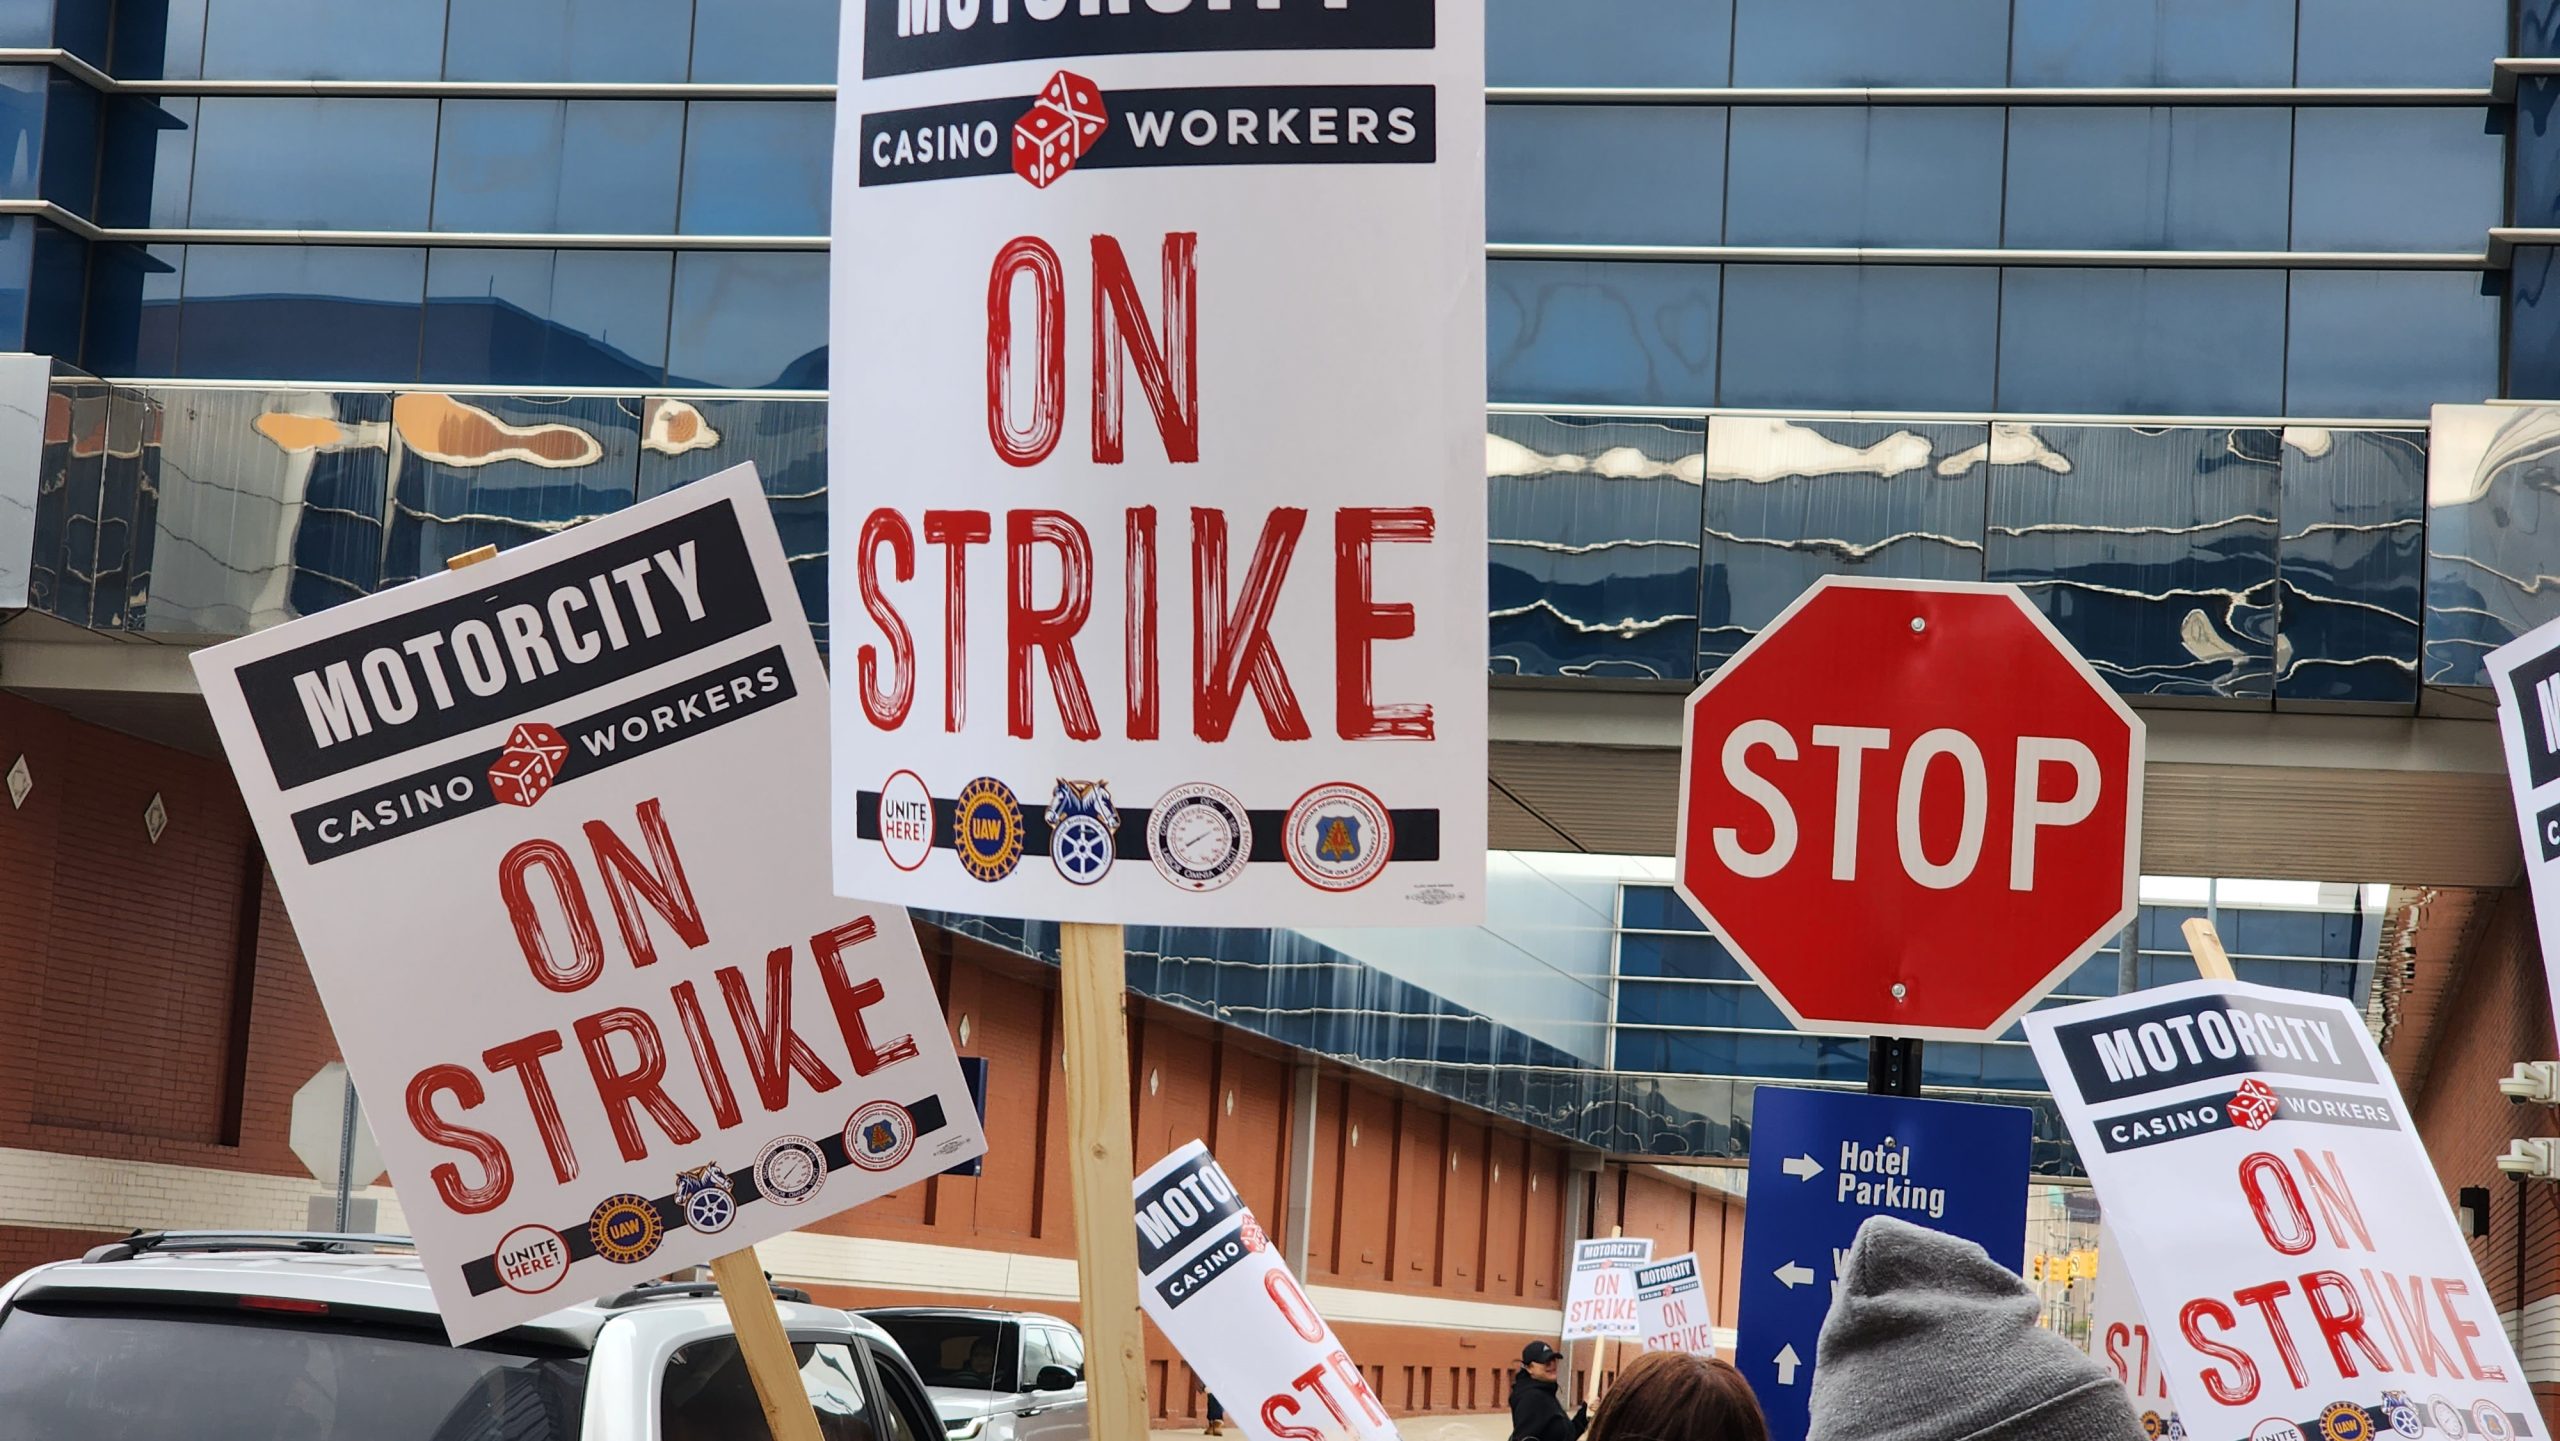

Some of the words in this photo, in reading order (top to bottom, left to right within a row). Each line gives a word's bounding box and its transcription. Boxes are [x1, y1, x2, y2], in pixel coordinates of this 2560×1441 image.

[872, 119, 998, 168] CASINO
[1126, 107, 1417, 149] WORKERS
[987, 232, 1199, 469] ON
[293, 540, 708, 750] MOTORCITY
[857, 504, 1436, 743] STRIKE
[317, 775, 474, 844] CASINO
[580, 666, 782, 757] WORKERS
[885, 799, 927, 821] UNITE
[1712, 719, 2102, 891] STOP
[886, 819, 926, 842] HERE!
[972, 818, 1001, 840] UAW
[499, 798, 709, 993] ON
[404, 914, 920, 1215] STRIKE
[2092, 1008, 2343, 1084] MOTORCITY
[2110, 1105, 2219, 1144] CASINO
[2284, 1097, 2391, 1124] WORKERS
[1840, 1141, 1910, 1176] Hotel
[1837, 1172, 1945, 1219] Parking
[2238, 1148, 2376, 1256] ON
[610, 1218, 640, 1240] UAW
[1583, 1243, 1641, 1259] MOTORCITY
[502, 1239, 558, 1267] UNITE
[507, 1252, 561, 1281] HERE!
[1169, 1241, 1240, 1297] CASINO
[1640, 1262, 1692, 1287] MOTORCITY
[1594, 1273, 1620, 1296] ON
[1570, 1298, 1637, 1323] STRIKE
[1663, 1299, 1688, 1328] ON
[2178, 1267, 2508, 1407] STRIKE
[2334, 1419, 2358, 1434] UAW
